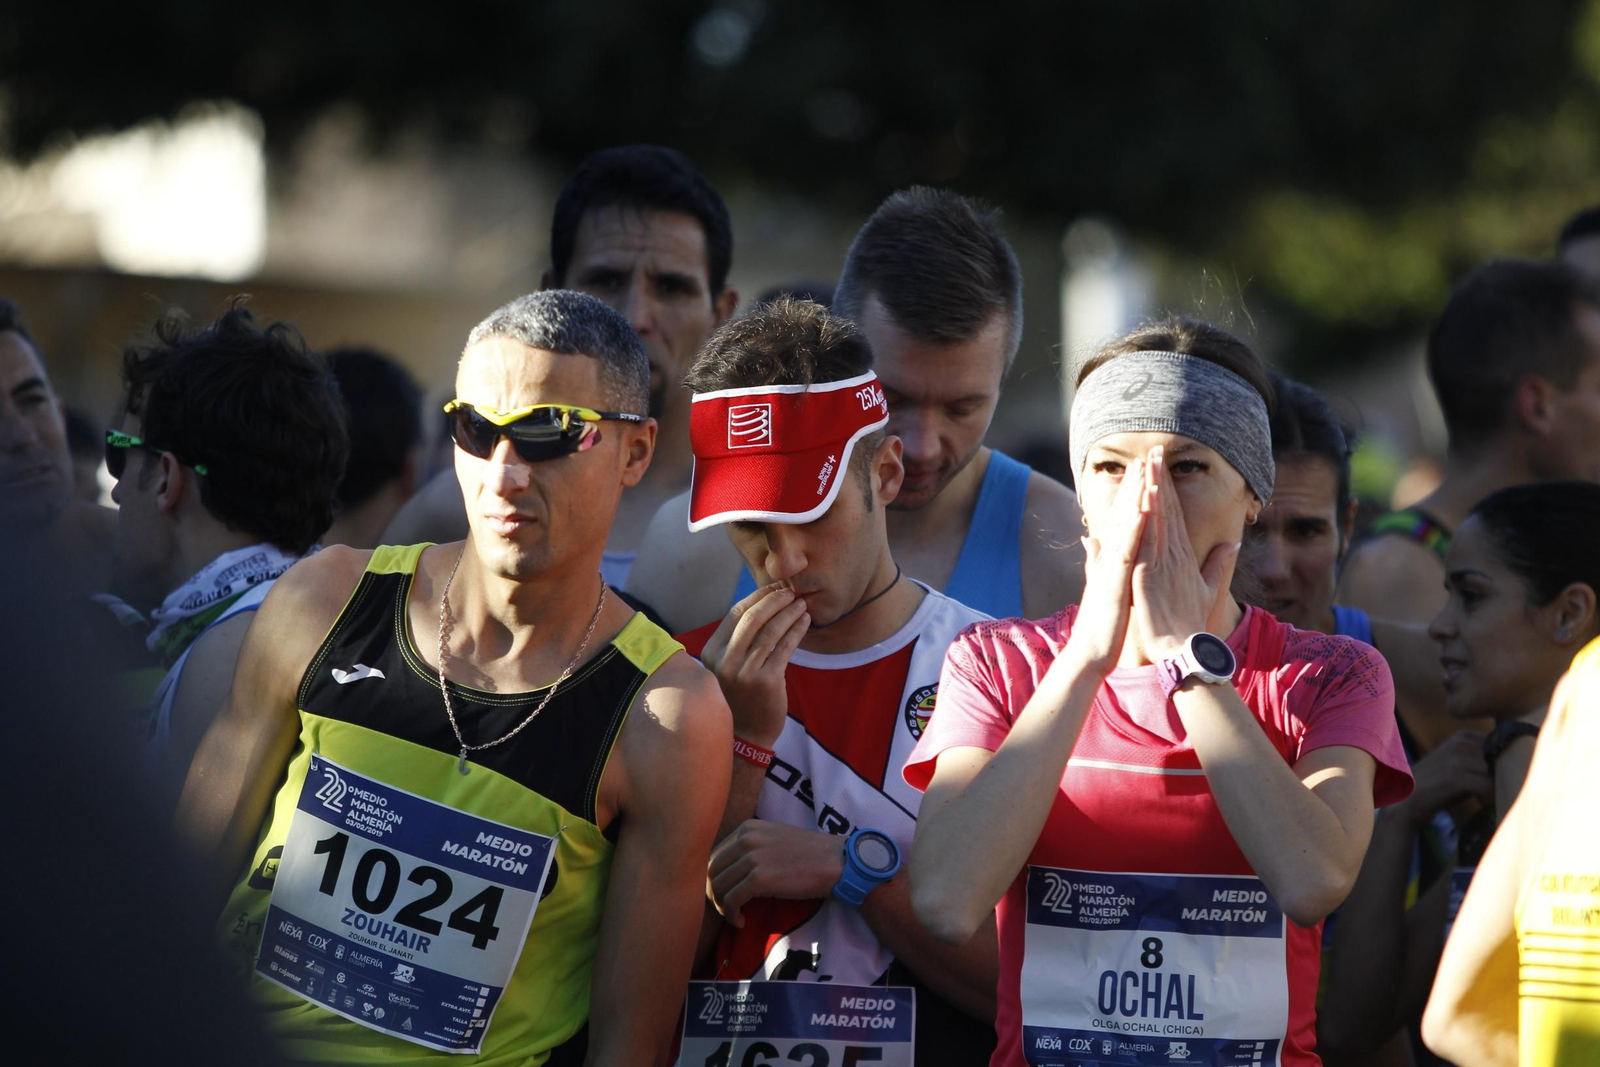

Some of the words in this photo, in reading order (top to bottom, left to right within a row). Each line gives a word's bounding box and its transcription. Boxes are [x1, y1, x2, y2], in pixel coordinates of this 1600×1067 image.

[856, 385, 879, 410] 25X
[354, 787, 388, 807] MEDIO
[350, 798, 403, 825] MARATÓN
[345, 818, 383, 837] 03/02/2019
[347, 810, 393, 834] ALMERÍA
[475, 832, 533, 857] MEDIO
[441, 840, 528, 875] MARATÓN
[313, 831, 505, 950] 1024
[1079, 884, 1115, 894] MEDIO
[1212, 890, 1267, 904] MEDIO
[1079, 894, 1135, 906] MARATÓN
[1079, 906, 1130, 917] ALMERÍA
[1181, 906, 1267, 923] MARATÓN
[1079, 917, 1121, 925] 03/02/2019
[279, 921, 303, 941] NEXA
[308, 933, 331, 950] CDX
[341, 907, 432, 954] ZOUHAIR
[274, 945, 298, 963] Blanes
[348, 932, 378, 948] ZOUHAIR
[379, 943, 387, 952] EL
[388, 946, 413, 960] JANATI
[1140, 937, 1164, 969] 8
[350, 951, 383, 969] ALMERÍA
[278, 967, 301, 983] cajamar
[458, 995, 475, 1003] FRUTA
[729, 994, 754, 1002] MEDIO
[1098, 970, 1204, 1020] OCHAL
[441, 1002, 457, 1010] EXTRA
[729, 1003, 768, 1013] MARATÓN
[840, 997, 896, 1011] MEDIO
[452, 1017, 468, 1025] TALLA
[728, 1013, 763, 1024] ALMERÍA
[811, 1014, 896, 1029] MARATÓN
[444, 1027, 464, 1036] MASAJE
[1092, 1018, 1121, 1031] OLGA
[1123, 1021, 1160, 1034] OCHAL
[1162, 1025, 1204, 1037] (CHICA)
[1036, 1038, 1062, 1050] NEXA
[1068, 1038, 1093, 1051] CDX
[1118, 1042, 1155, 1052] ALMERÍA
